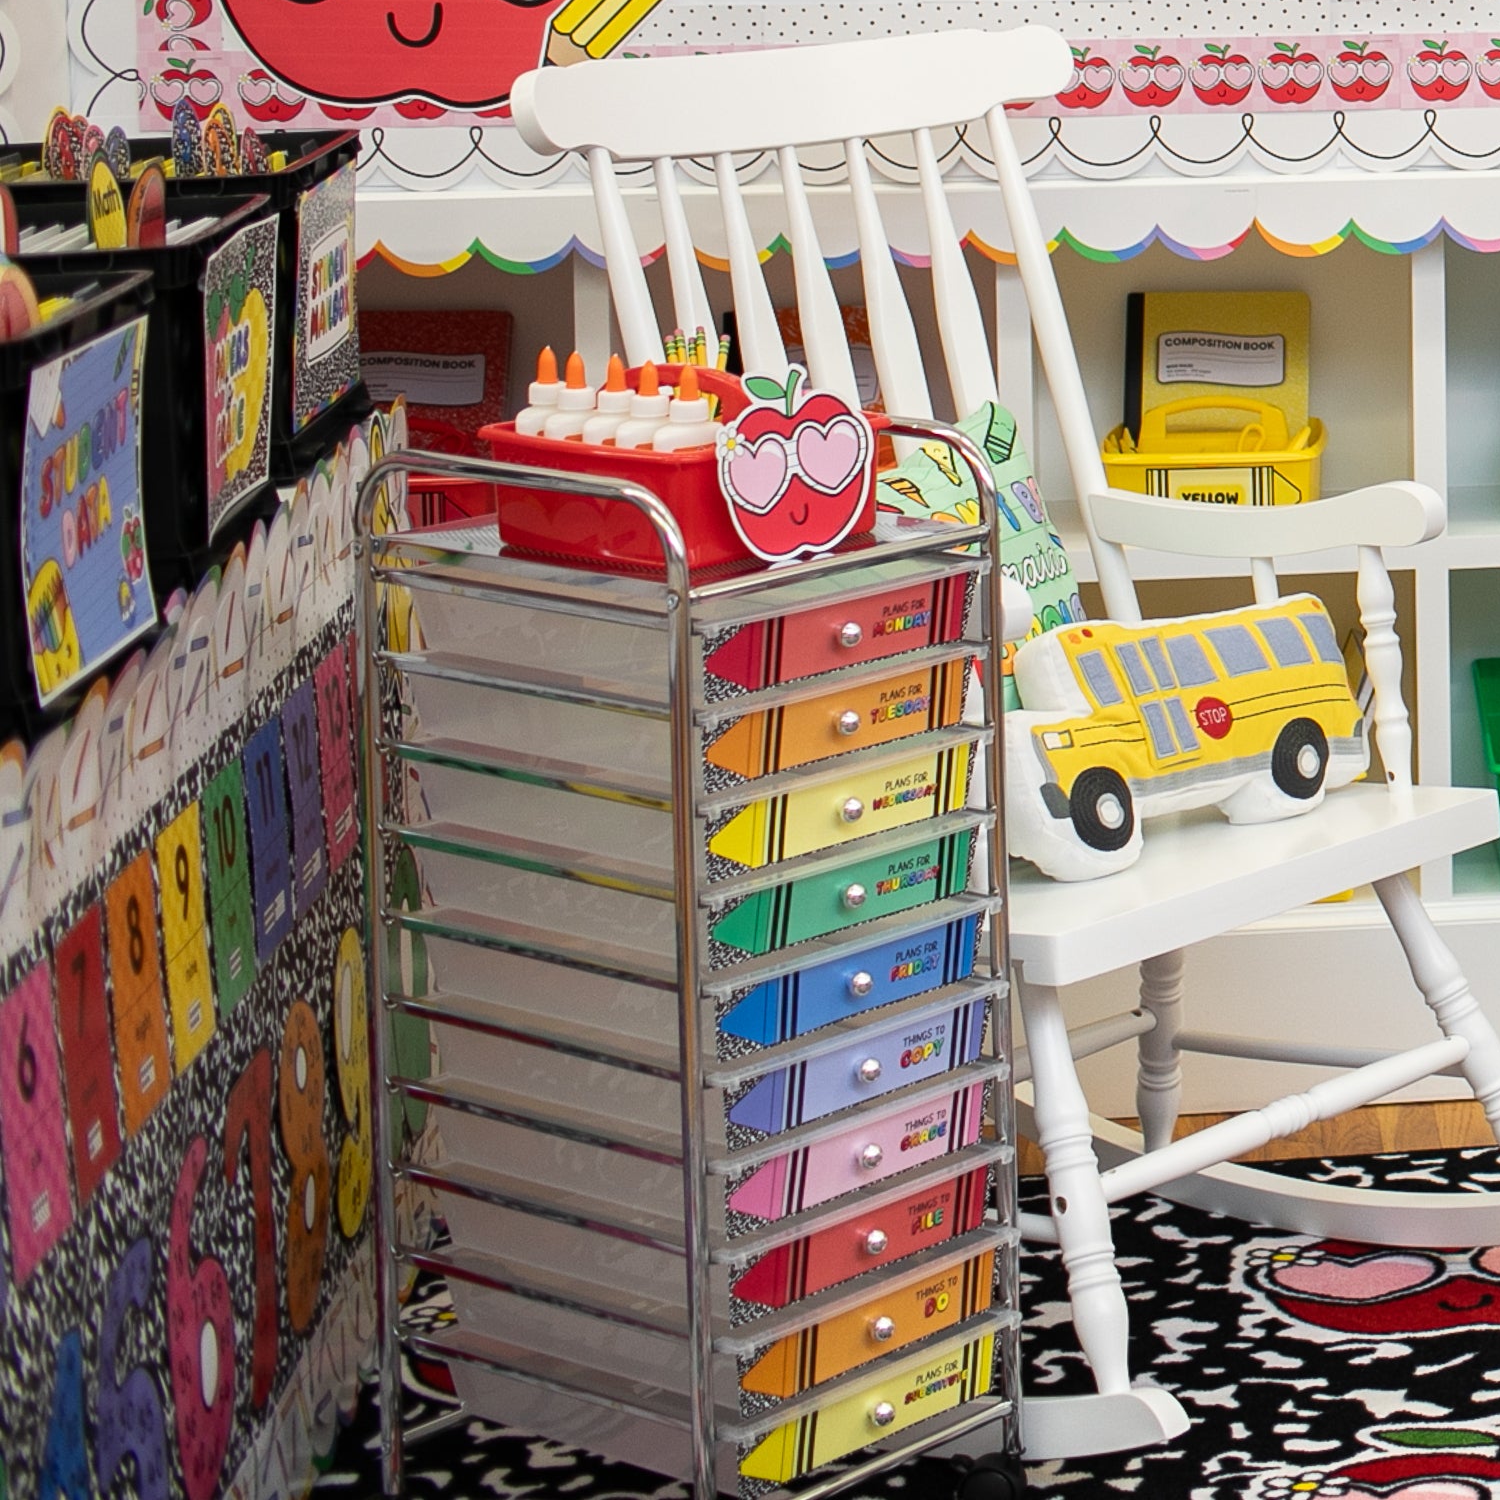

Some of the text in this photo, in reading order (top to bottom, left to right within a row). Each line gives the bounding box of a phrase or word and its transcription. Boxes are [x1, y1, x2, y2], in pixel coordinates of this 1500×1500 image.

[92, 187, 122, 221] Math
[1165, 338, 1275, 351] COMPOSITION BOOK
[40, 387, 128, 520] STUDENT
[62, 475, 113, 570] DATA
[883, 598, 926, 617] PLANS FOR
[872, 610, 931, 638] MONDAY
[880, 683, 922, 702] PLANS FOR
[870, 695, 931, 725] TUESDAY
[1199, 707, 1227, 726] STOP
[213, 794, 236, 876] 10
[174, 843, 190, 922] 9
[126, 895, 145, 975] 8
[895, 941, 938, 962] PLANS FOR
[889, 953, 940, 982] FRIDAY
[903, 1025, 946, 1047] THINGS TO
[900, 1039, 945, 1069] COPY
